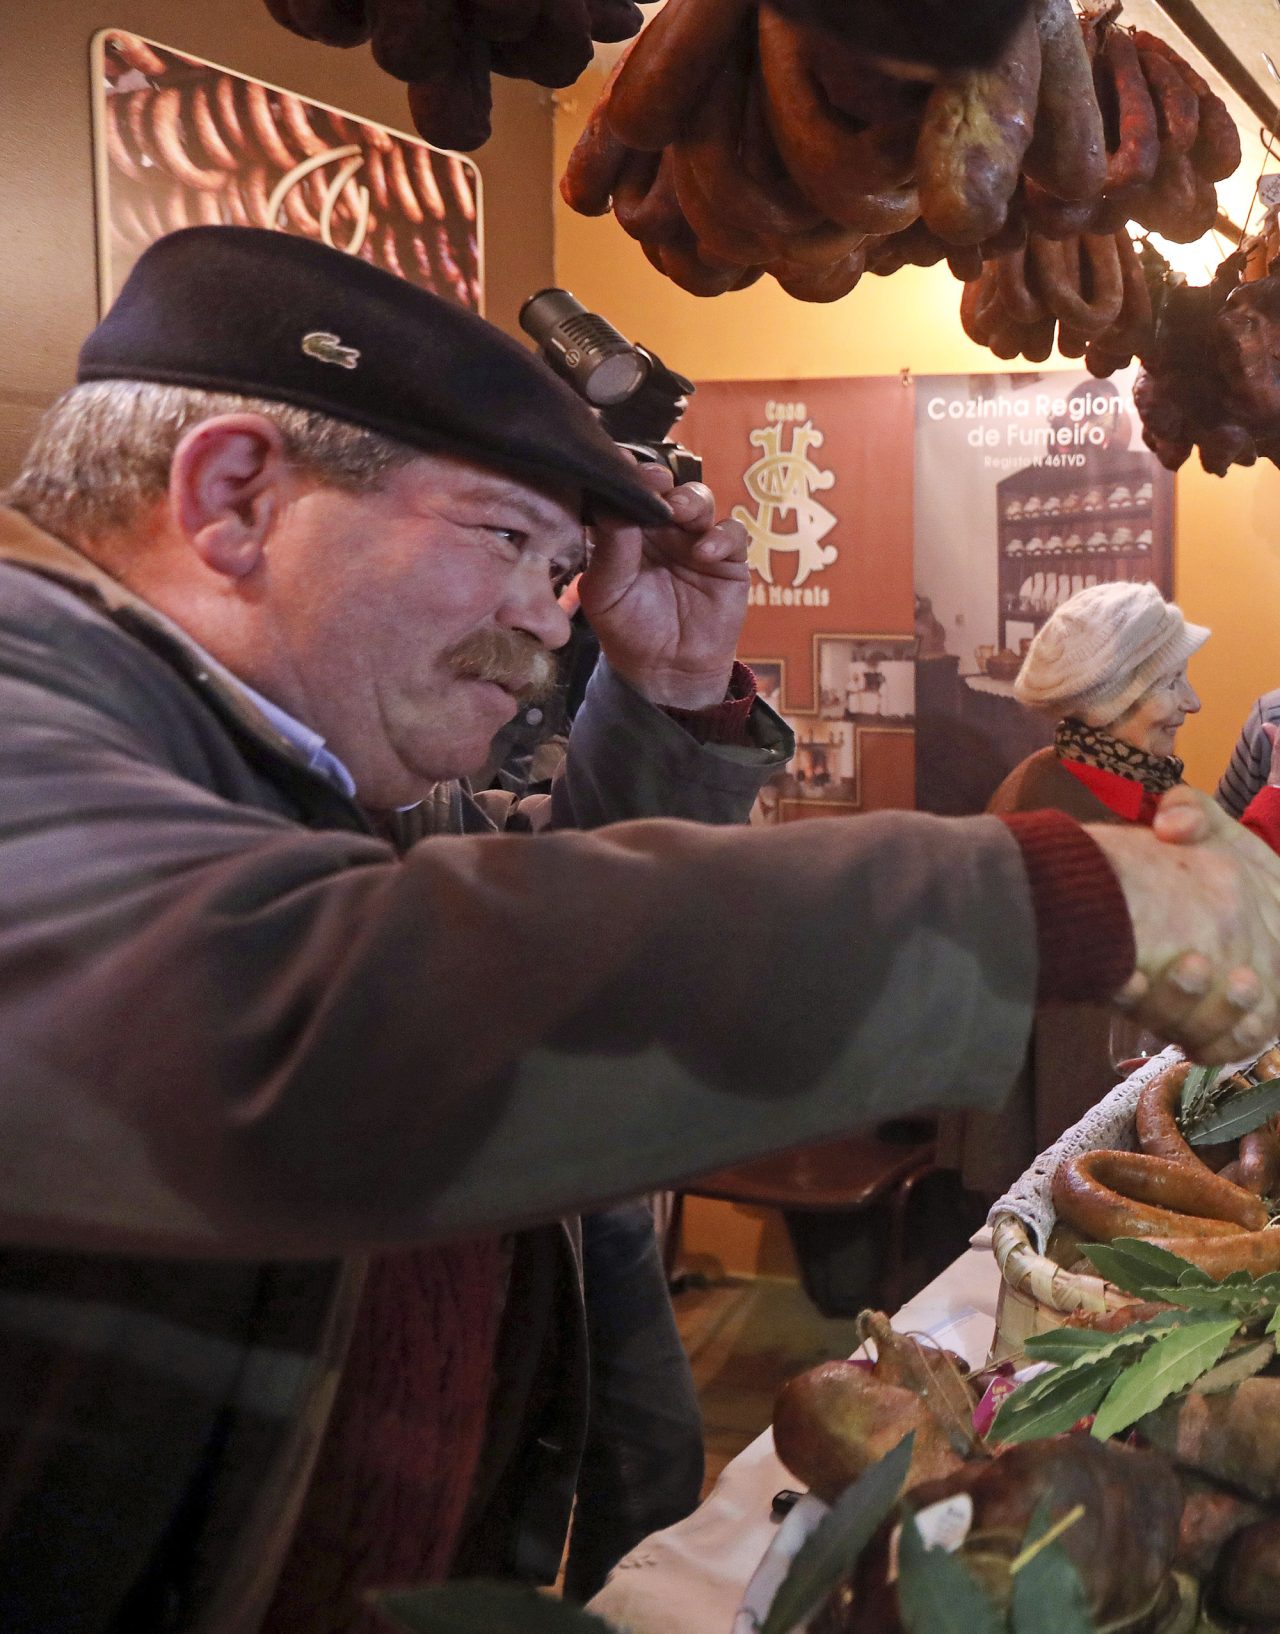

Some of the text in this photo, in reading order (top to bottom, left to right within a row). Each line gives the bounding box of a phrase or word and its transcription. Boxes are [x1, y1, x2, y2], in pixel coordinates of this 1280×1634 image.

[927, 392, 1137, 421] Cozinha Regiona
[968, 423, 1105, 447] de Fumeiro
[769, 584, 830, 607] Morais
